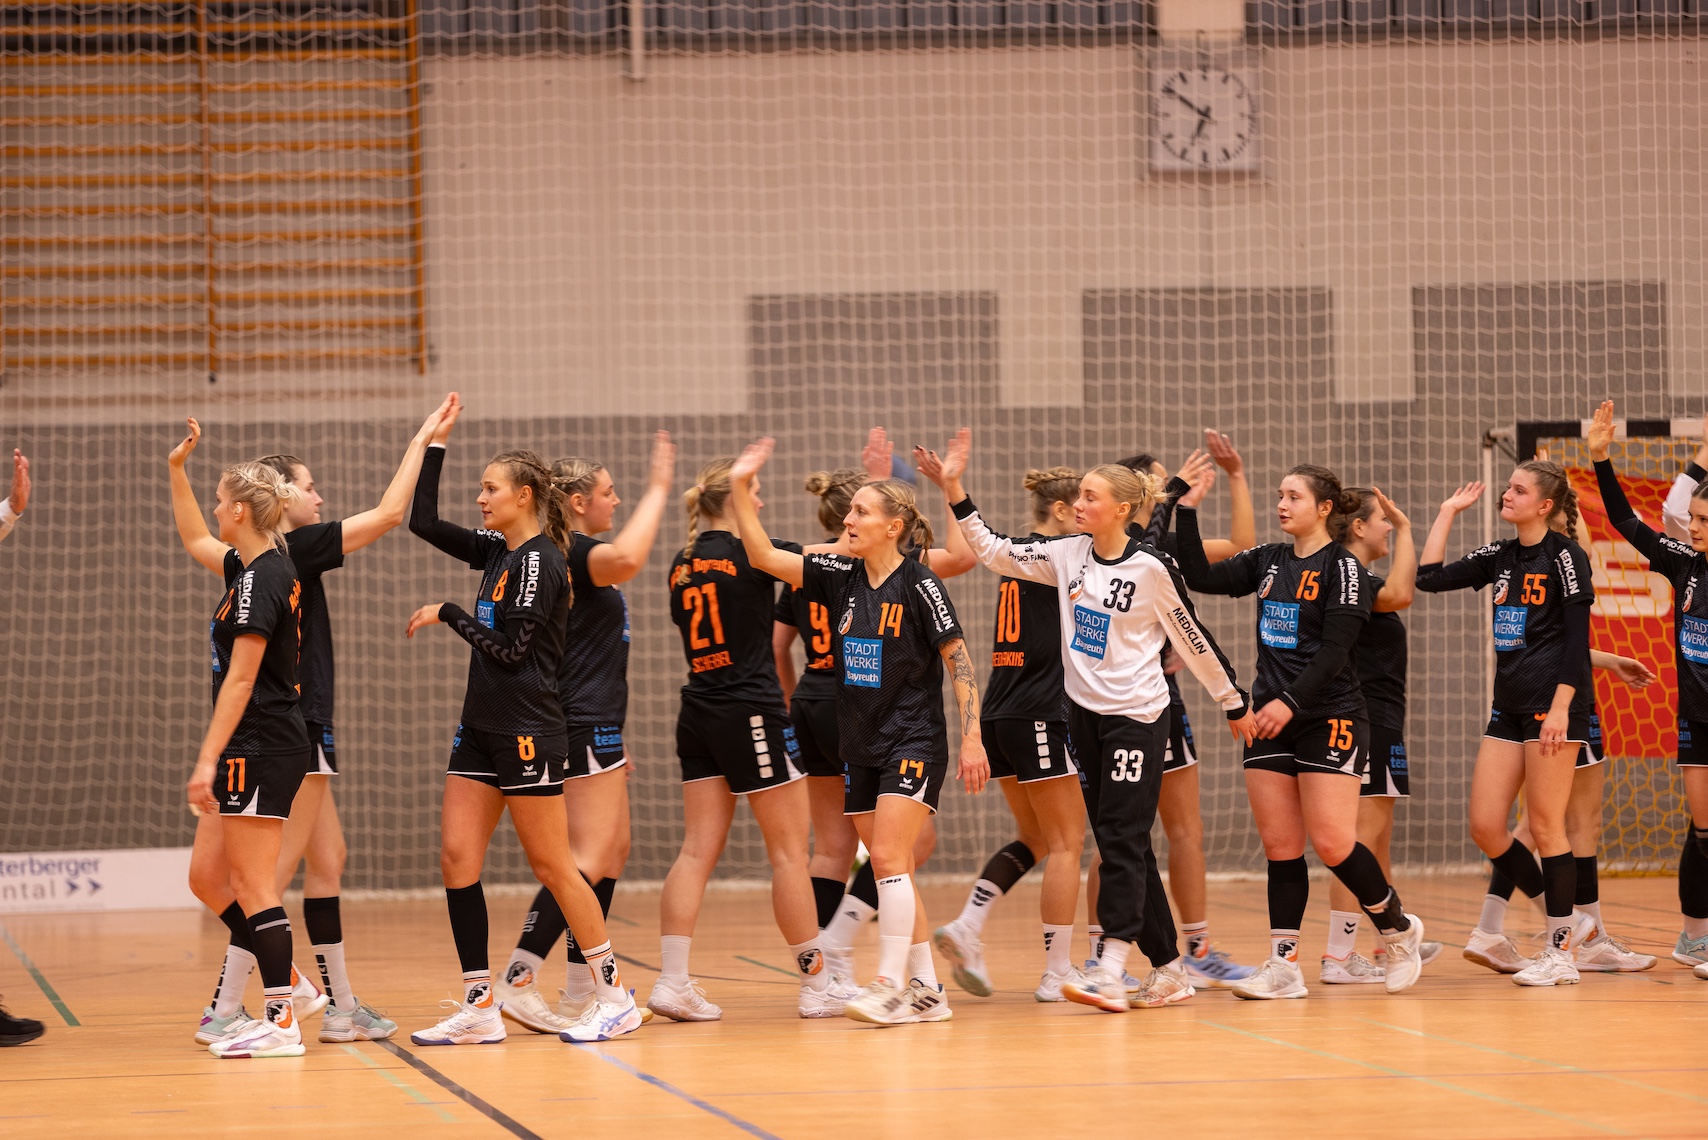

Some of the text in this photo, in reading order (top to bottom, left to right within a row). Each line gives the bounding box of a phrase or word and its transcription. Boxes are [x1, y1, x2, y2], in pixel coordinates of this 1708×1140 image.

[492, 570, 509, 602] 8
[522, 551, 540, 607] MEDICLIN
[1296, 570, 1320, 601] 15
[1345, 557, 1359, 605] MEDICLIN
[1521, 573, 1549, 606] 55
[921, 578, 955, 631] MEDICLIN
[1103, 578, 1135, 613] 33
[682, 582, 725, 650] 21
[877, 602, 904, 638] 14
[997, 580, 1020, 643] 10
[1075, 609, 1108, 629] STADT
[1264, 618, 1295, 632] WERKE
[1265, 604, 1296, 619] STADT
[1497, 610, 1525, 622] STADT
[809, 601, 832, 654] 9
[1075, 624, 1106, 643] WERKE
[1172, 607, 1208, 655] MEDICLIN
[1261, 631, 1296, 645] Bayreuth
[1494, 622, 1522, 635] WERKE
[1682, 631, 1708, 647] WERK
[845, 641, 880, 656] STADT
[1074, 637, 1104, 655] Bayreuth
[1494, 637, 1523, 647] Bayreuth
[844, 655, 879, 670] WERKE
[847, 670, 879, 682] Bayreuth
[517, 736, 535, 761] 8
[594, 733, 622, 747] team
[1327, 718, 1353, 751] 15
[226, 757, 246, 793] 11
[1111, 748, 1144, 783] 33
